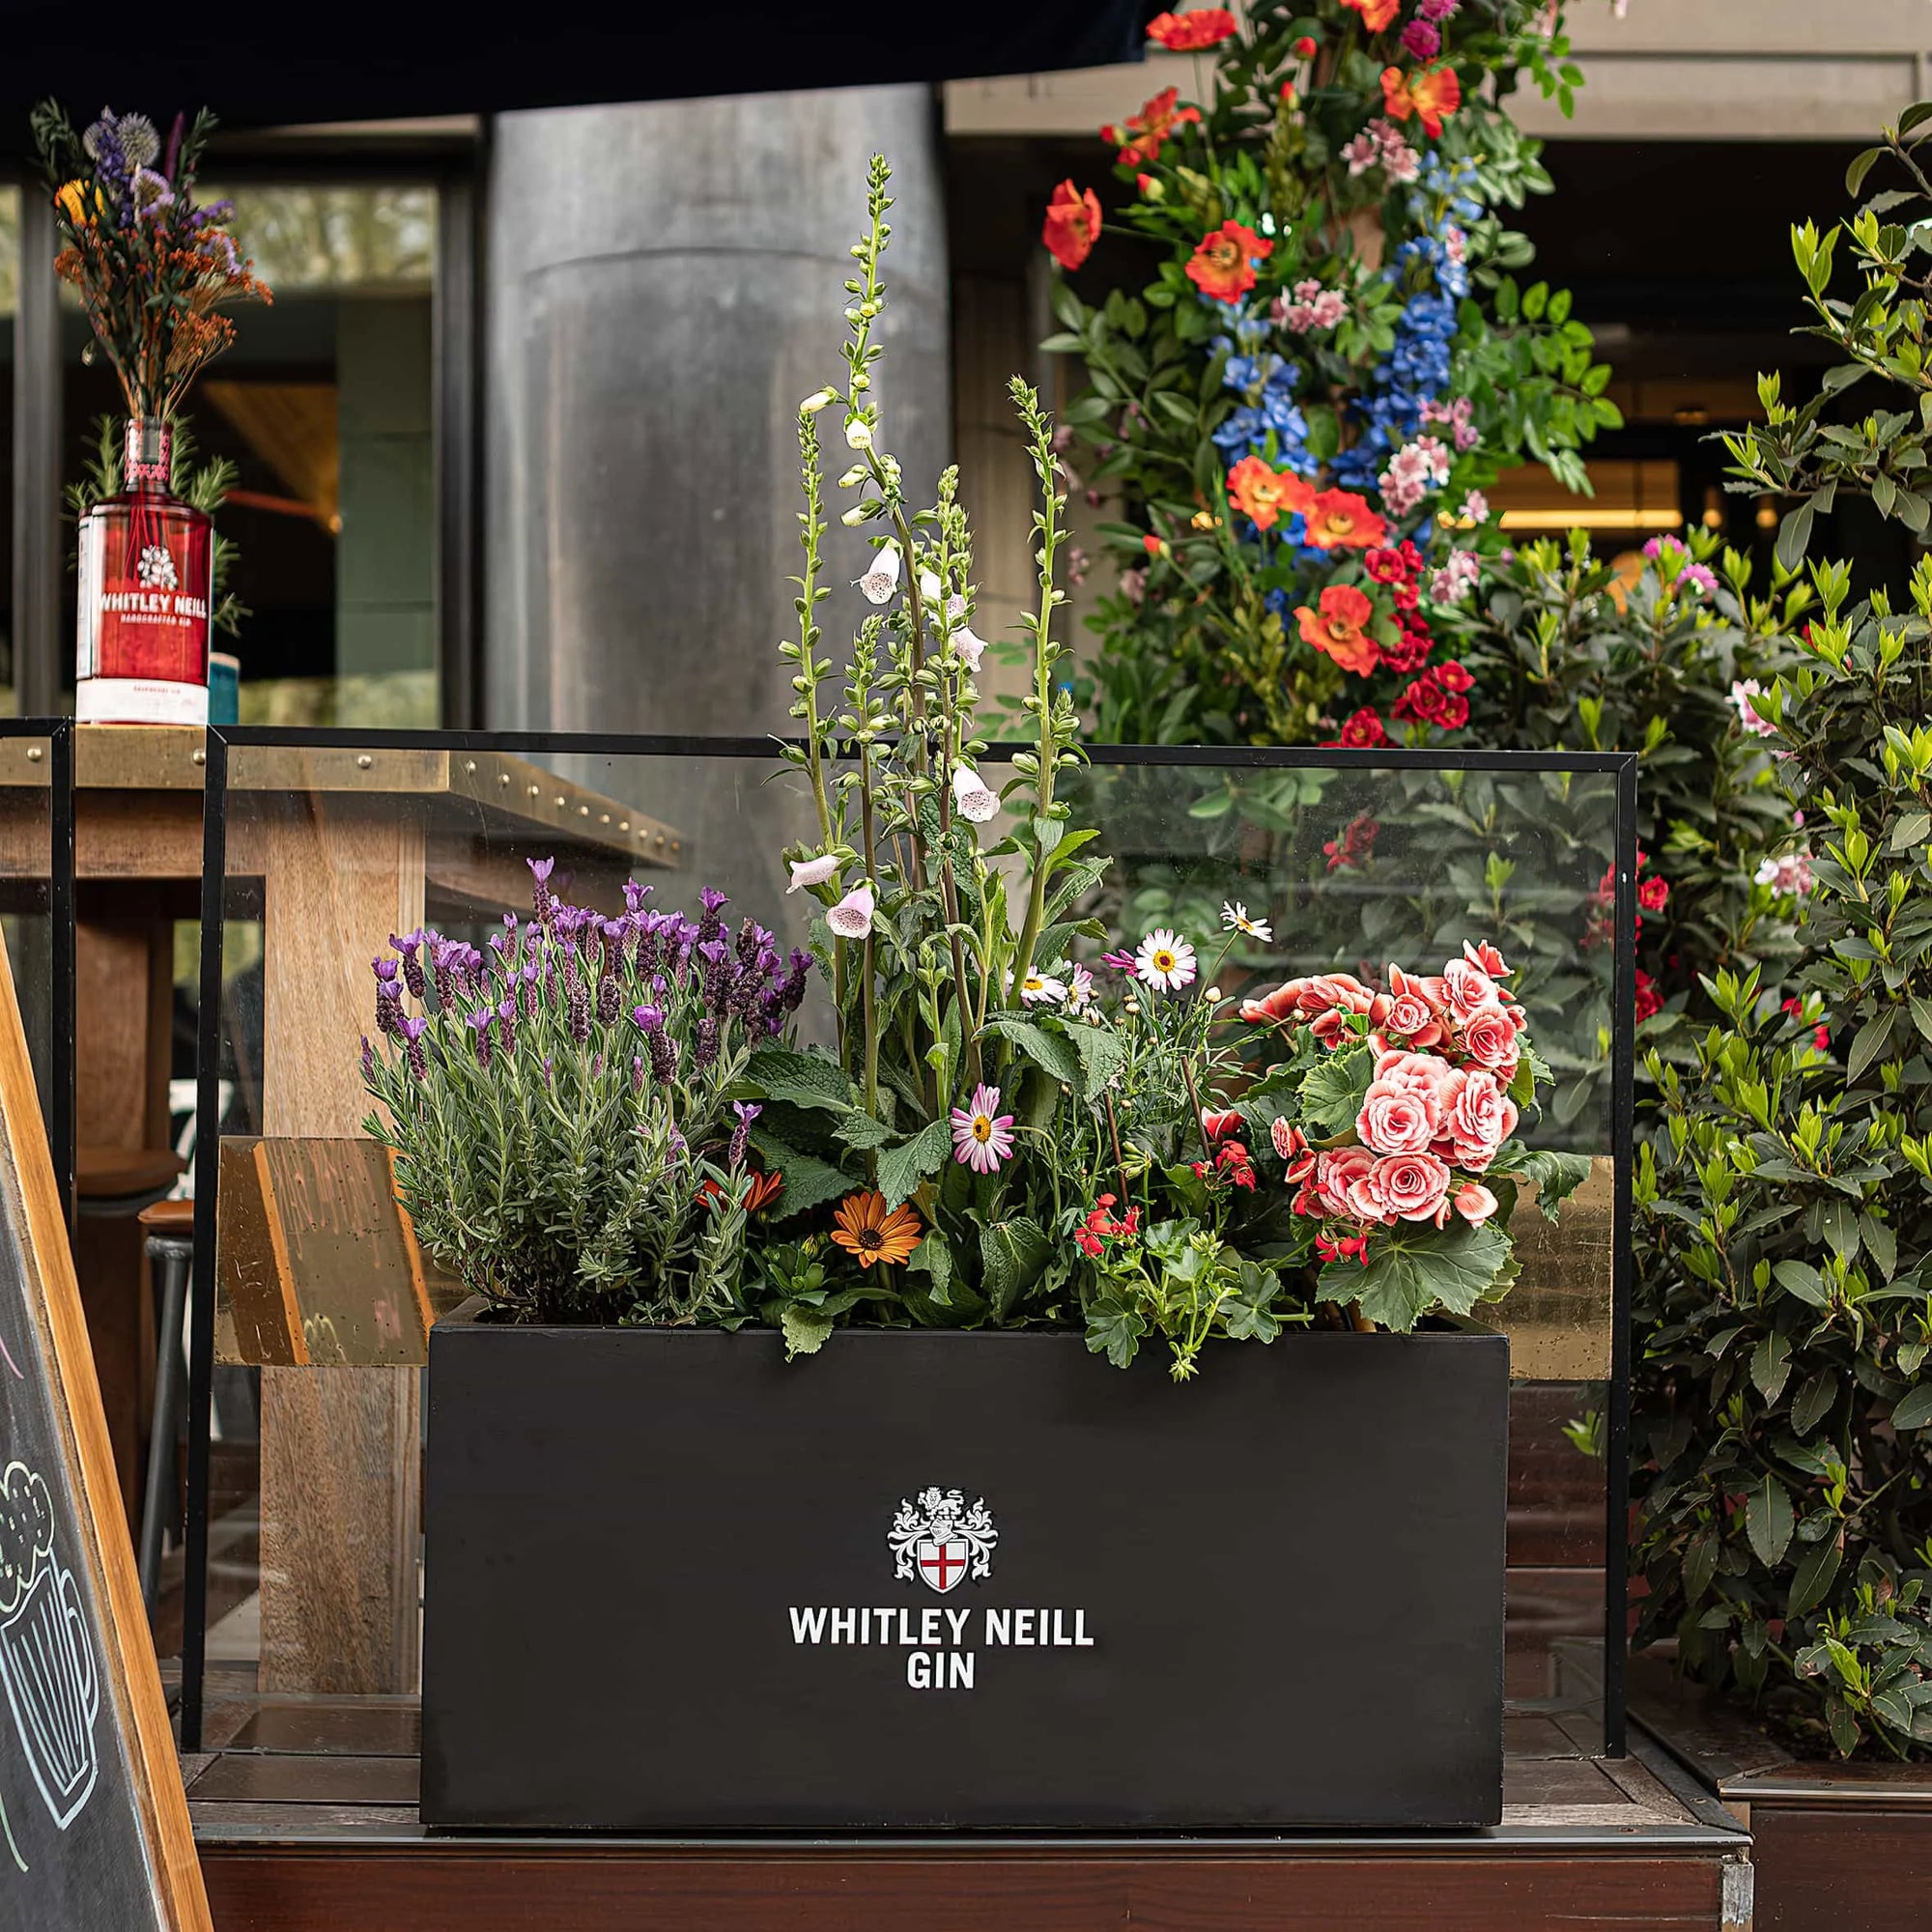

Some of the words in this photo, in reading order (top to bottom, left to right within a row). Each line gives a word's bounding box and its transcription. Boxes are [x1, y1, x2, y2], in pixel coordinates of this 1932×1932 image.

[99, 592, 171, 613] WHITLEY
[174, 595, 207, 619] NEILL
[788, 1606, 971, 1645] WHITLEY
[985, 1608, 1094, 1646] NEILL
[907, 1651, 975, 1690] GIN
